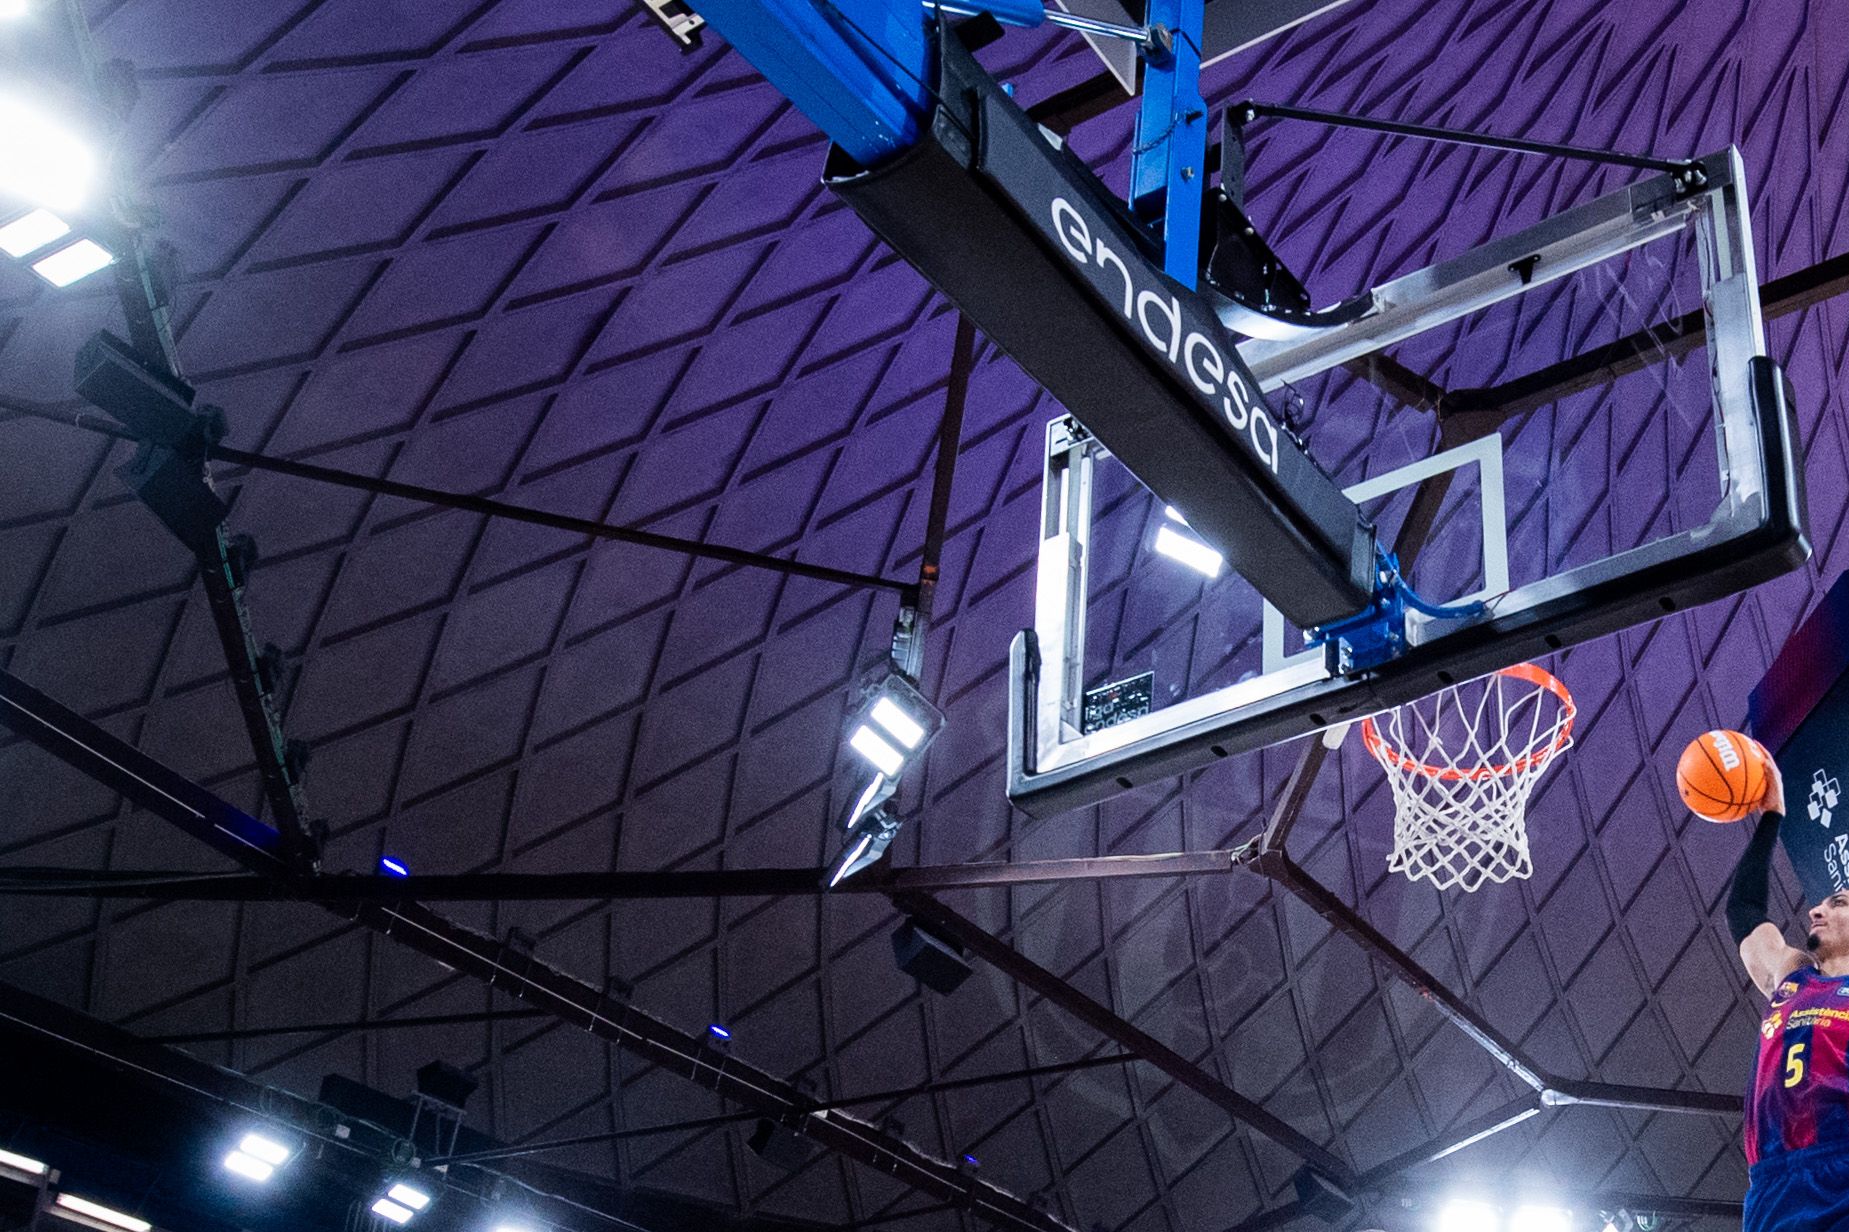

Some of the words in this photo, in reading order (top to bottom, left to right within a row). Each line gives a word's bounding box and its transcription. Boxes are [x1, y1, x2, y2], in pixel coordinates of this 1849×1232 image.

[1051, 197, 1278, 474] endesa
[1824, 843, 1845, 892] Sani
[1784, 1042, 1806, 1089] 5
